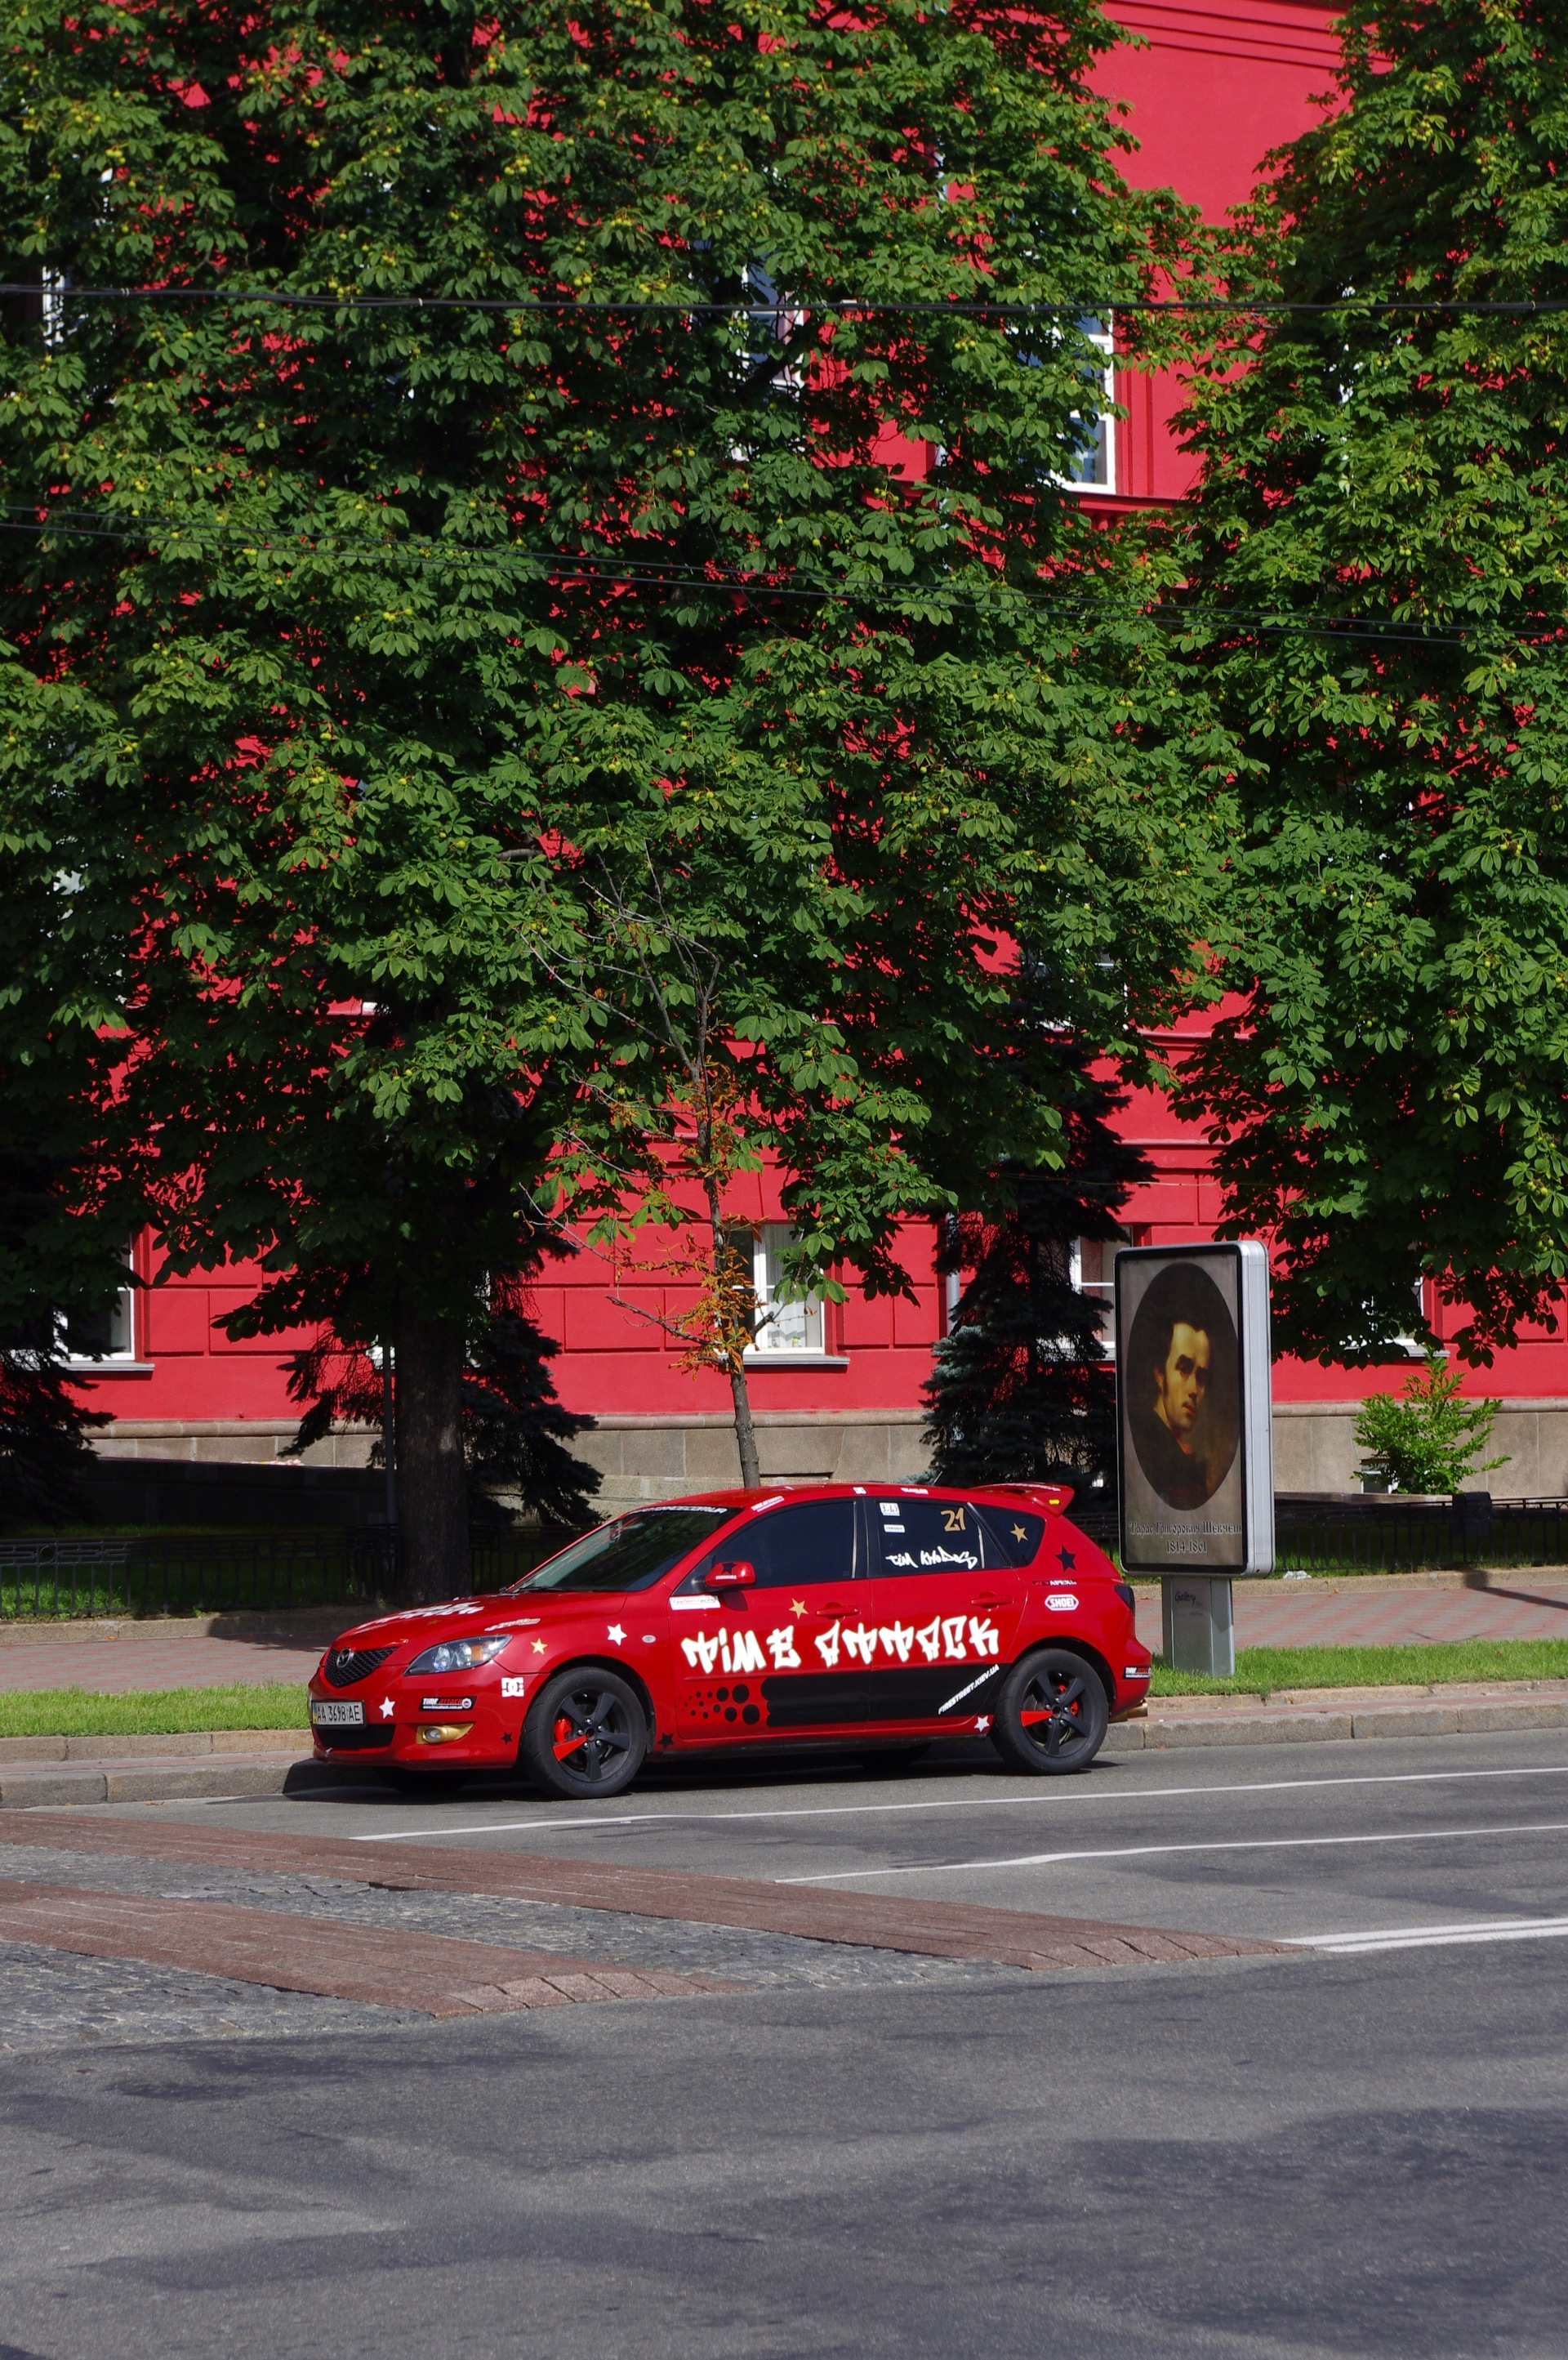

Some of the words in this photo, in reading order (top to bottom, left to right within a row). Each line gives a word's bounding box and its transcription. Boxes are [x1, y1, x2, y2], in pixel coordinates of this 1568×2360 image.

[941, 1507, 966, 1532] 21
[1129, 1522, 1153, 1537] Тарас
[1156, 1521, 1200, 1538] Григорович
[1049, 1598, 1074, 1608] SHOEI
[814, 1616, 999, 1667] ATTACK
[938, 1663, 1000, 1715] FIRESTREET.KIEV.UA
[318, 1705, 326, 1721] AA
[328, 1705, 346, 1721] 3698
[349, 1705, 361, 1721] AE
